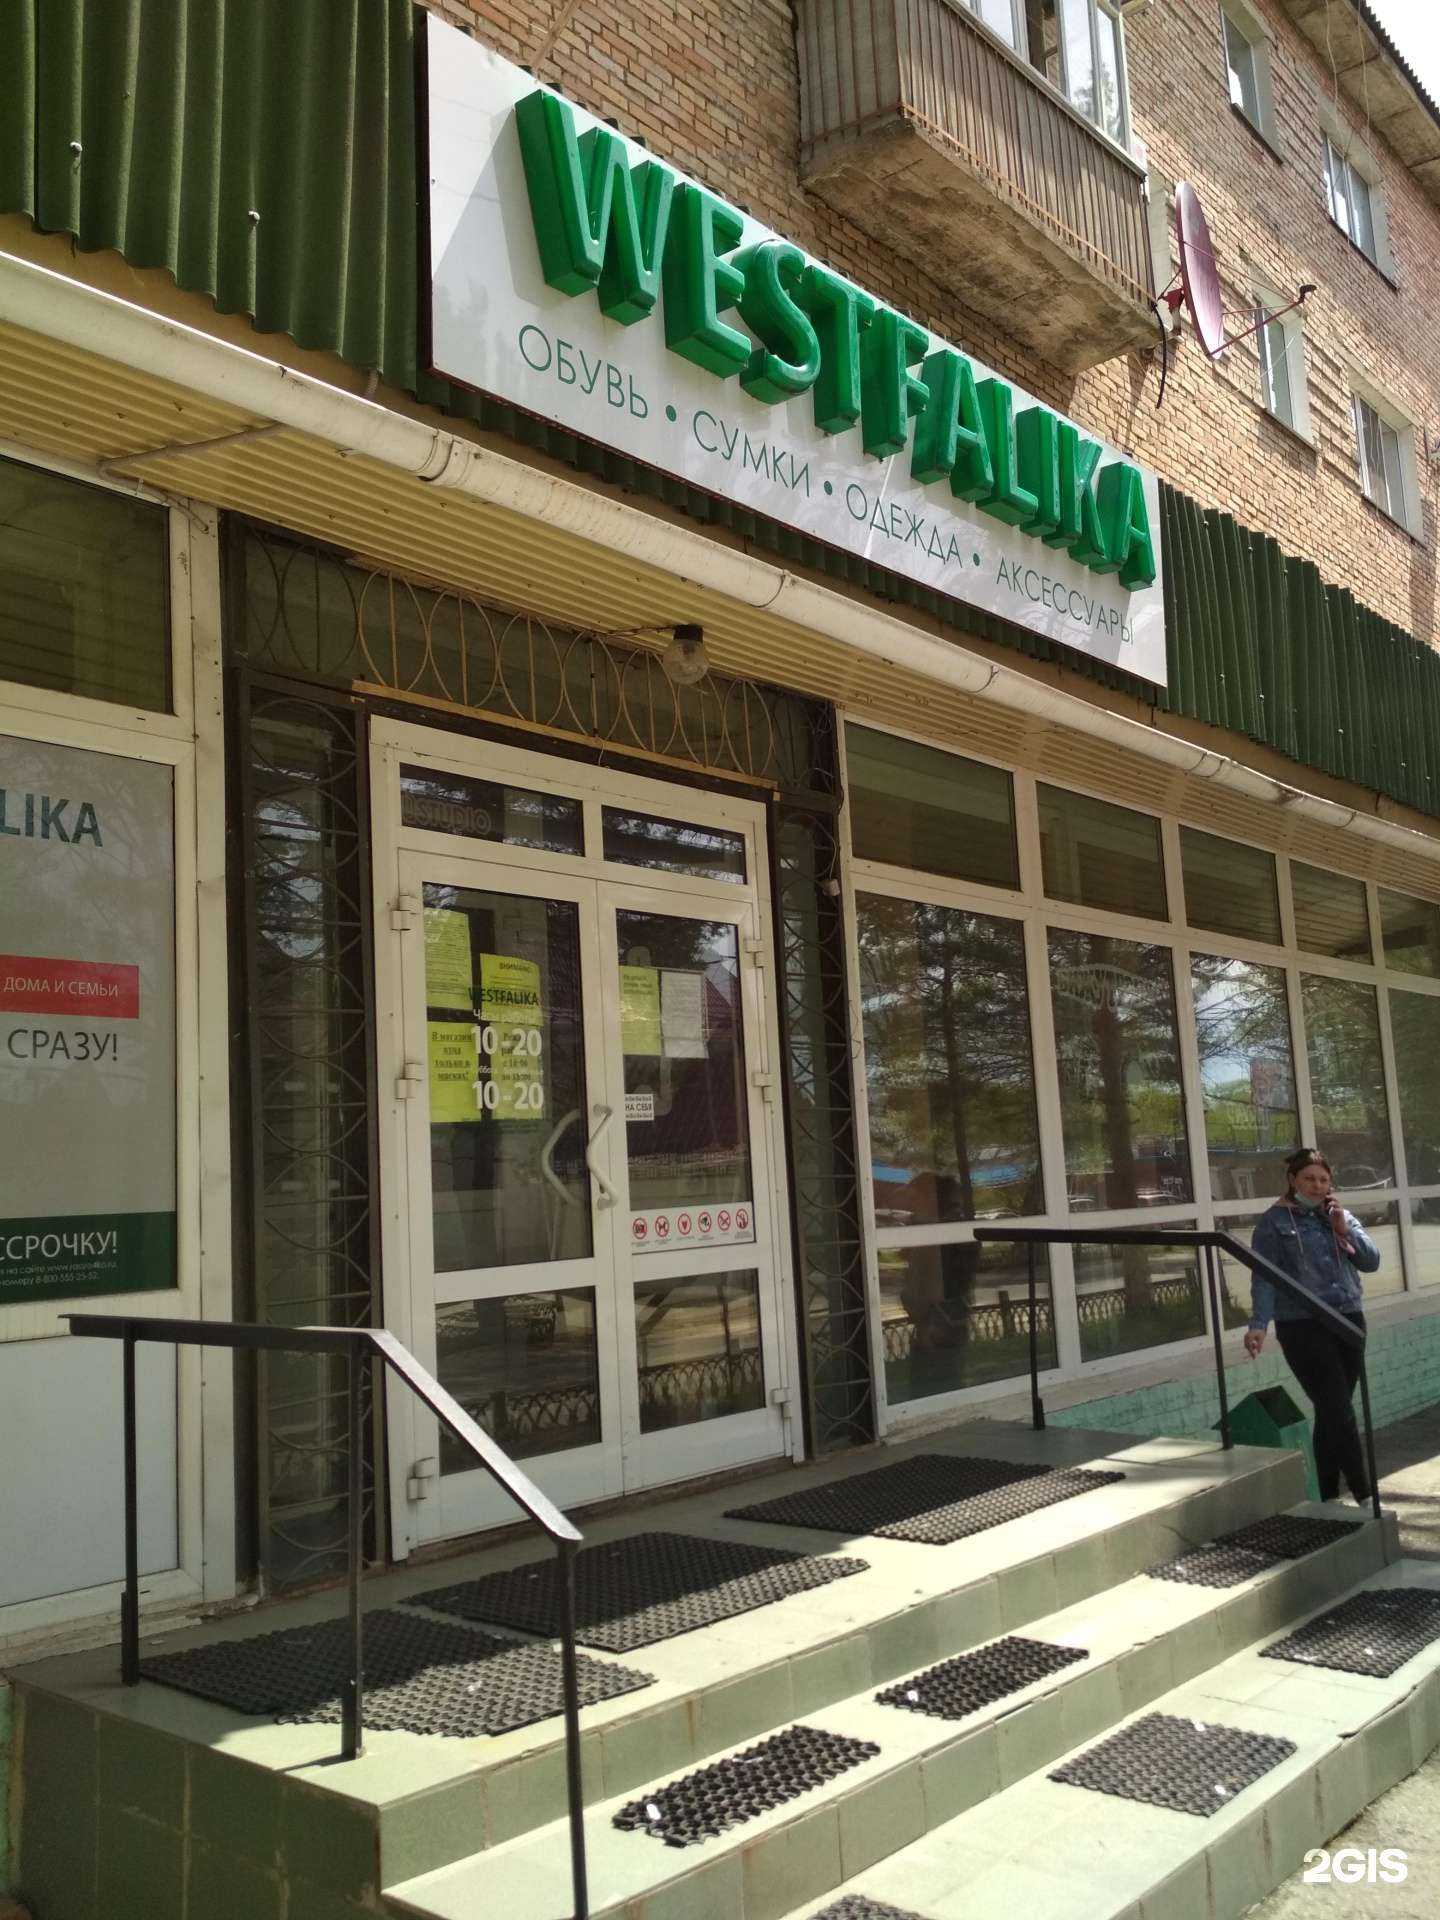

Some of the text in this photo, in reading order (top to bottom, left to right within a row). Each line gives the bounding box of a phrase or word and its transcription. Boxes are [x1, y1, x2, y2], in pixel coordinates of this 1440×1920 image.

[516, 89, 1156, 591] WESTFALIKA
[518, 323, 1135, 646] ОБУВЬ СУМКИ ОДЕЖДА АКСЕССУАРЫ
[0, 789, 103, 847] LIKA
[3, 976, 119, 998] ДОМА И СЕМЬИ
[468, 986, 539, 1006] WESTFALIKA
[7, 1028, 118, 1062] СРАЗУ!
